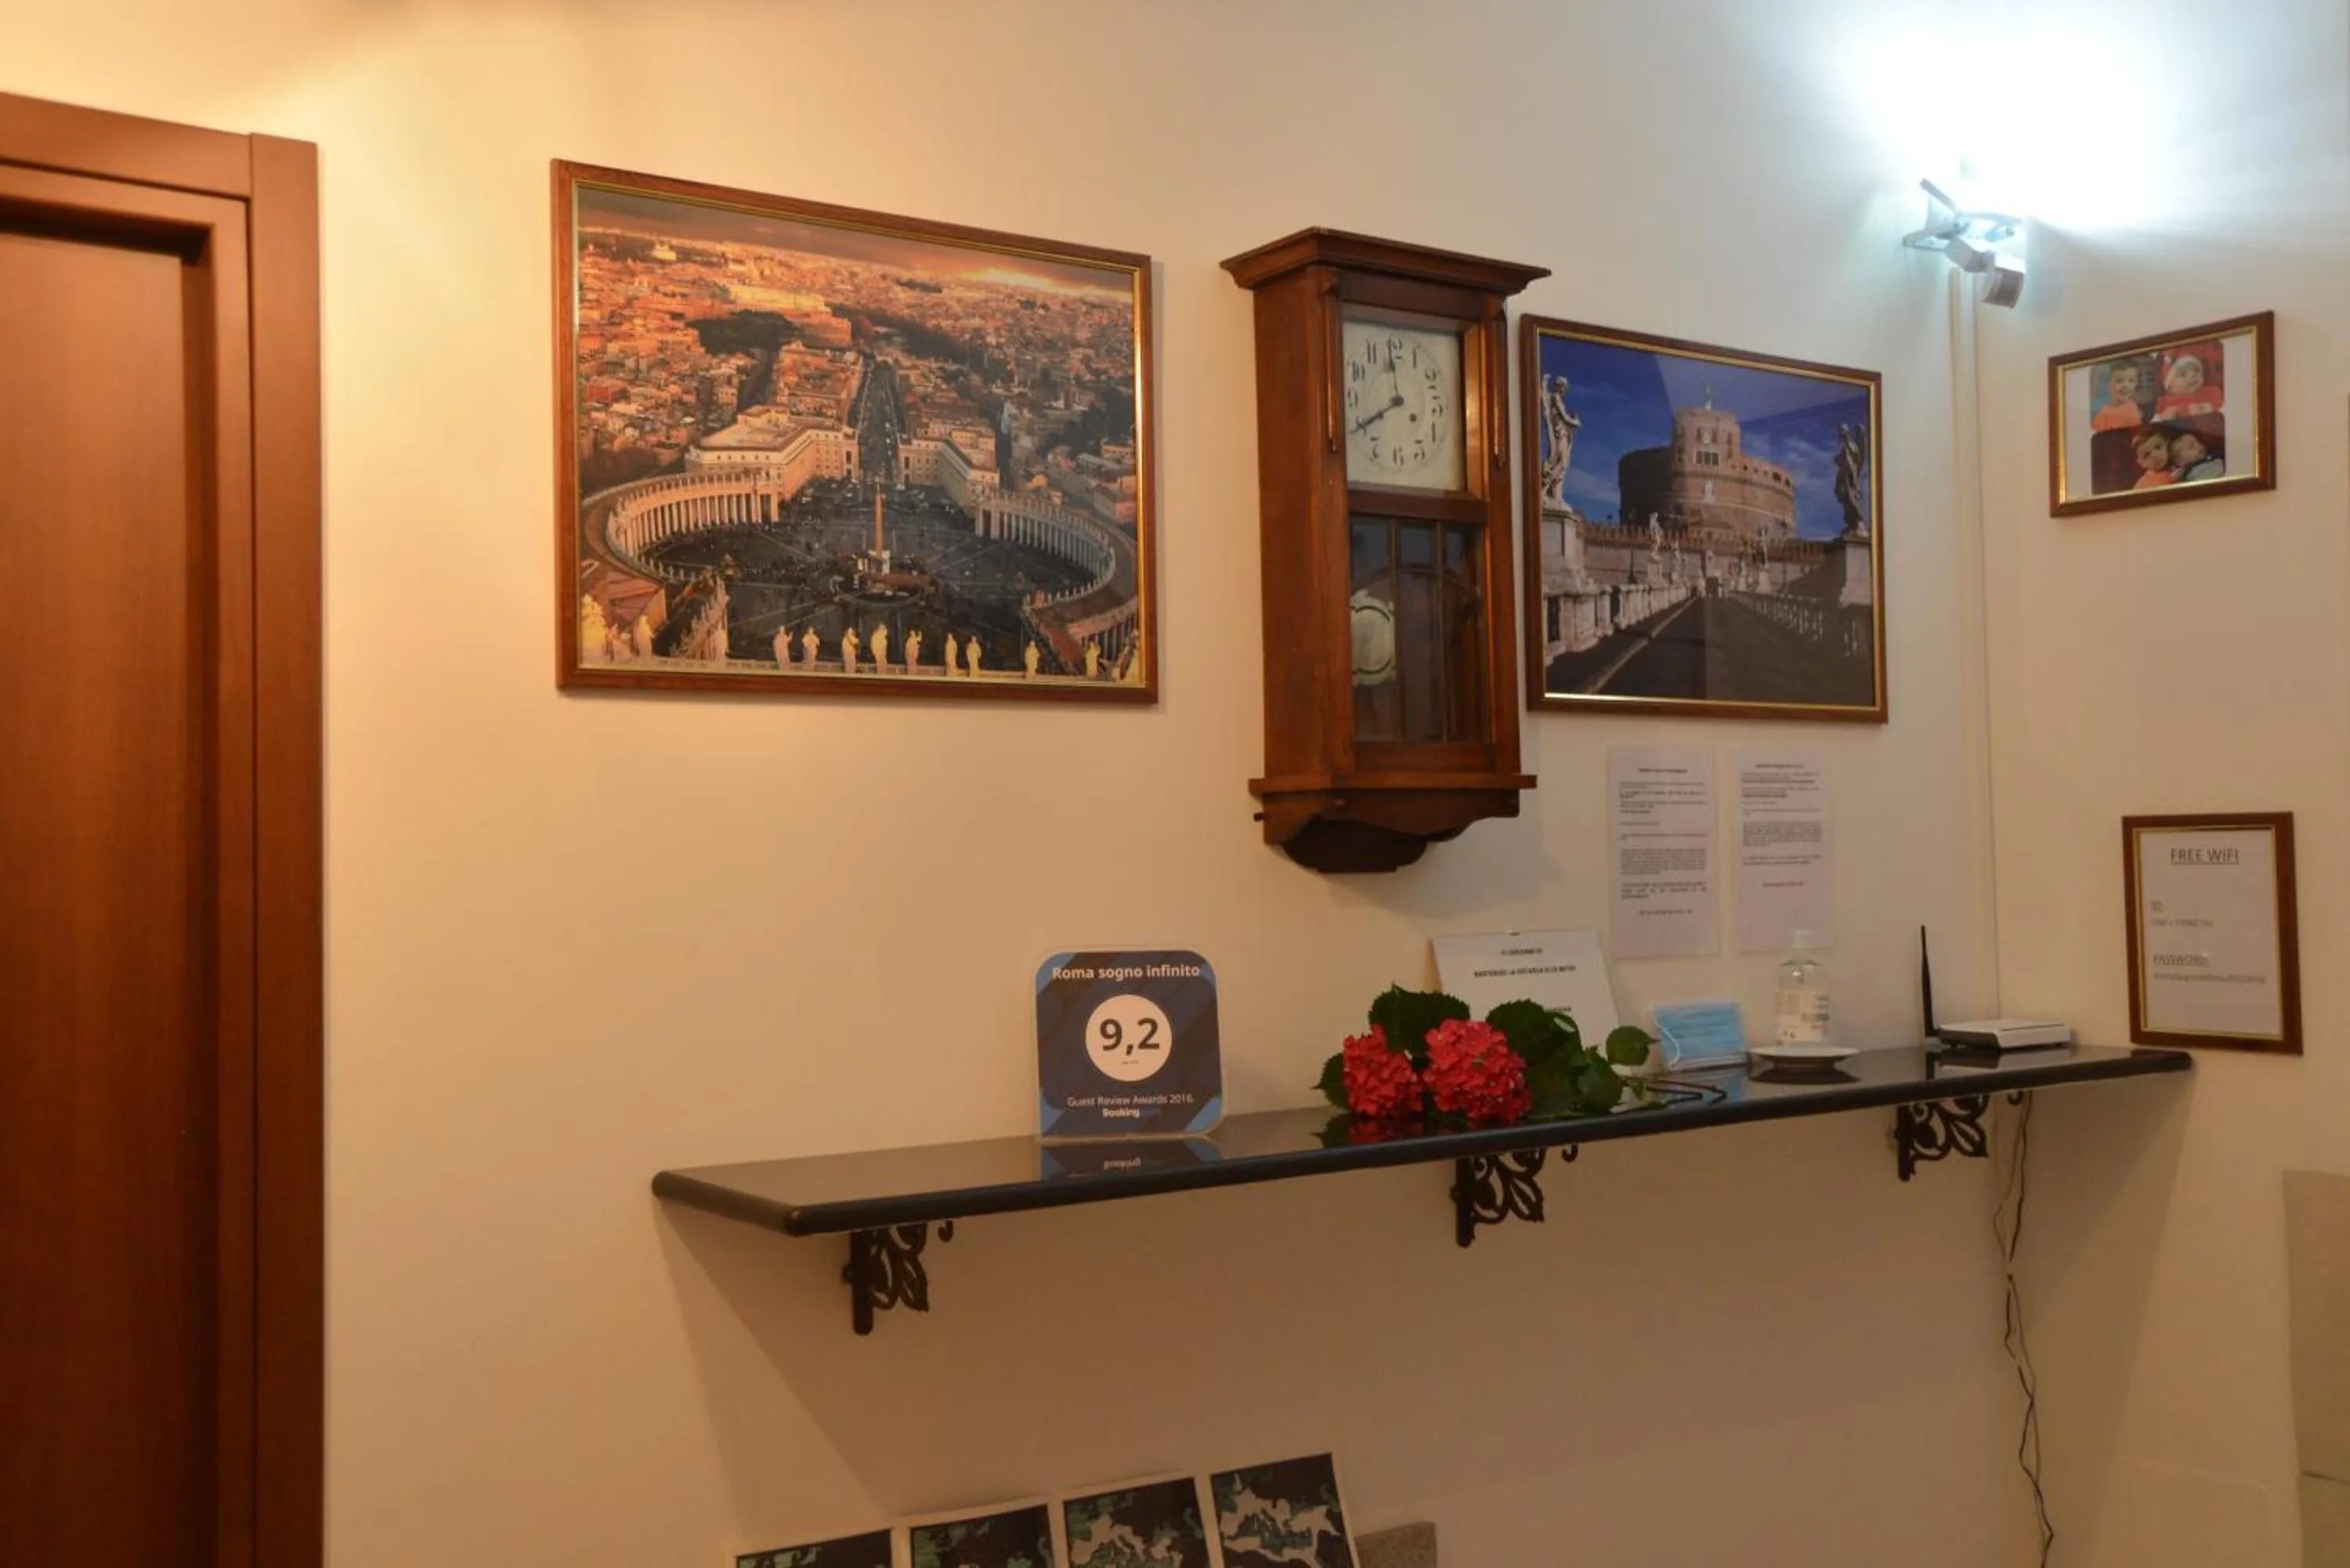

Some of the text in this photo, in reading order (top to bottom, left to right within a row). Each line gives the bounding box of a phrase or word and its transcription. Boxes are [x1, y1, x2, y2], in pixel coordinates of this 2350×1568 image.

[1365, 338, 1377, 364] 11
[1387, 337, 1403, 359] 2
[1424, 367, 1437, 390] 2
[1392, 445, 1405, 467] 6
[2171, 847, 2240, 865] FREE WIFI
[1052, 964, 1201, 981] Roma sogno infinito
[1100, 1018, 1160, 1056] 9,2
[1067, 1097, 1095, 1107] Guest
[1097, 1095, 1131, 1106] Review
[1133, 1094, 1168, 1104] Awards
